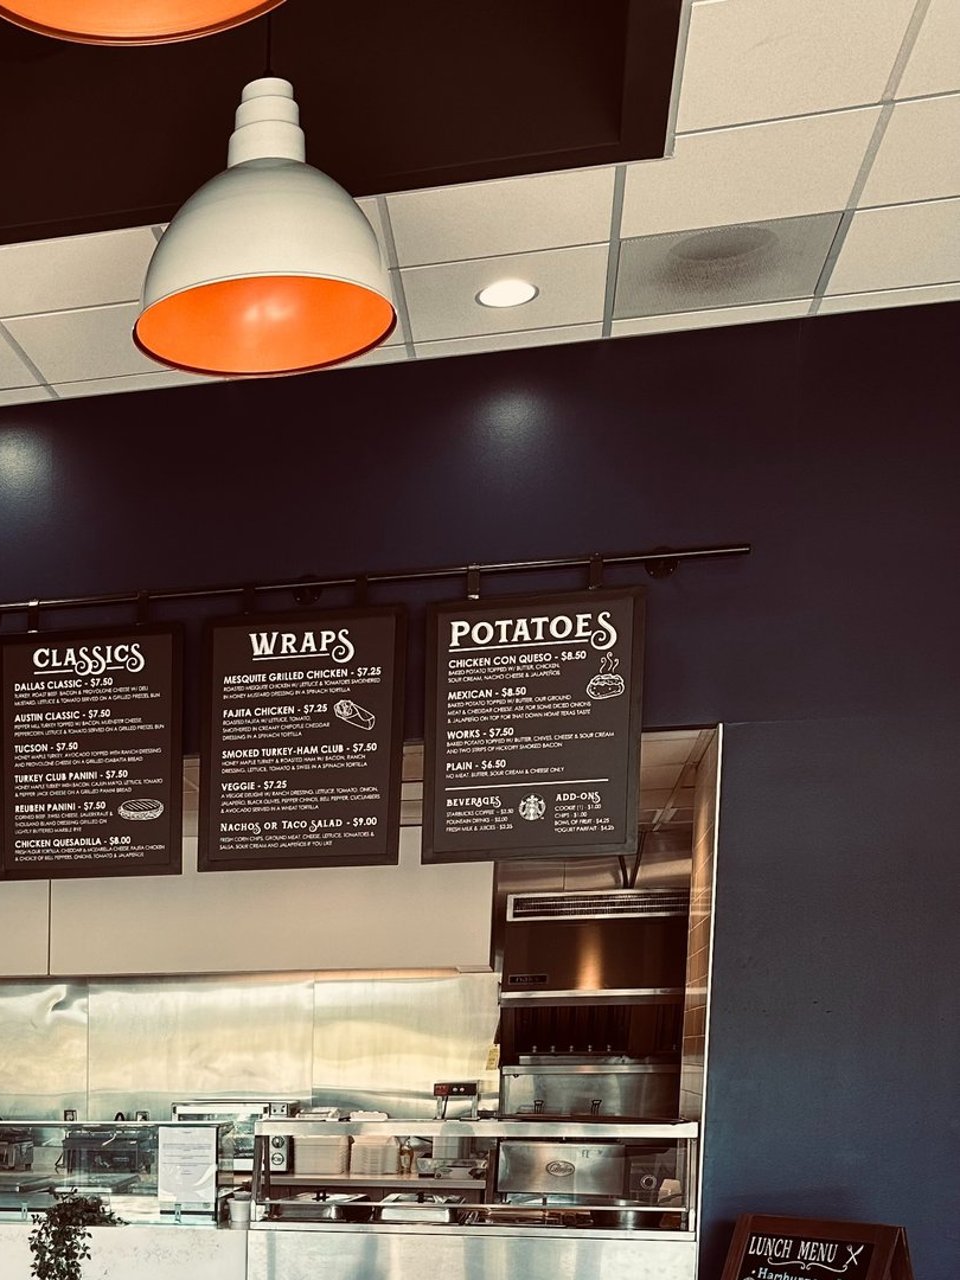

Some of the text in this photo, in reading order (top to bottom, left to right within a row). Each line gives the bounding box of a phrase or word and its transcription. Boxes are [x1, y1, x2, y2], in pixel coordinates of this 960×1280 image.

[449, 612, 617, 650] POTATOES
[249, 629, 354, 663] WRAPS
[33, 643, 145, 676] CLASSICS
[448, 651, 587, 669] CHICKEN CON QUESO $8.50
[223, 667, 382, 684] MESQUITE GRILLED CHICKEN $7.25
[14, 678, 114, 692] DALLAS CLASSIC $7.50
[447, 687, 527, 700] MEXICAN $8.50
[14, 710, 111, 722] AUSTIN CLASSIC $7.50
[223, 704, 328, 718] FAJITA CHICKEN $7.25
[446, 728, 514, 739] WORKS $7.50
[14, 742, 78, 753] TUCSON $7.50
[221, 743, 378, 759] SMOKED TURKEY-HAM CLUB $7.50
[446, 760, 507, 771] PLAIN $6.50
[14, 770, 129, 783] TURKEY CLUB PANINI $7.50
[221, 781, 288, 791] VEGGIE $7.25
[447, 796, 501, 808] BEVERAGES
[556, 791, 601, 803] ADD-ONS
[14, 802, 106, 812] REUBEN PANINI $7.50
[220, 817, 378, 834] NACHOS OR TACO SALAD $9.00
[14, 837, 132, 848] CHICKEN QUESADILLA $8.00
[749, 1236, 838, 1262] LUNCH MENU
